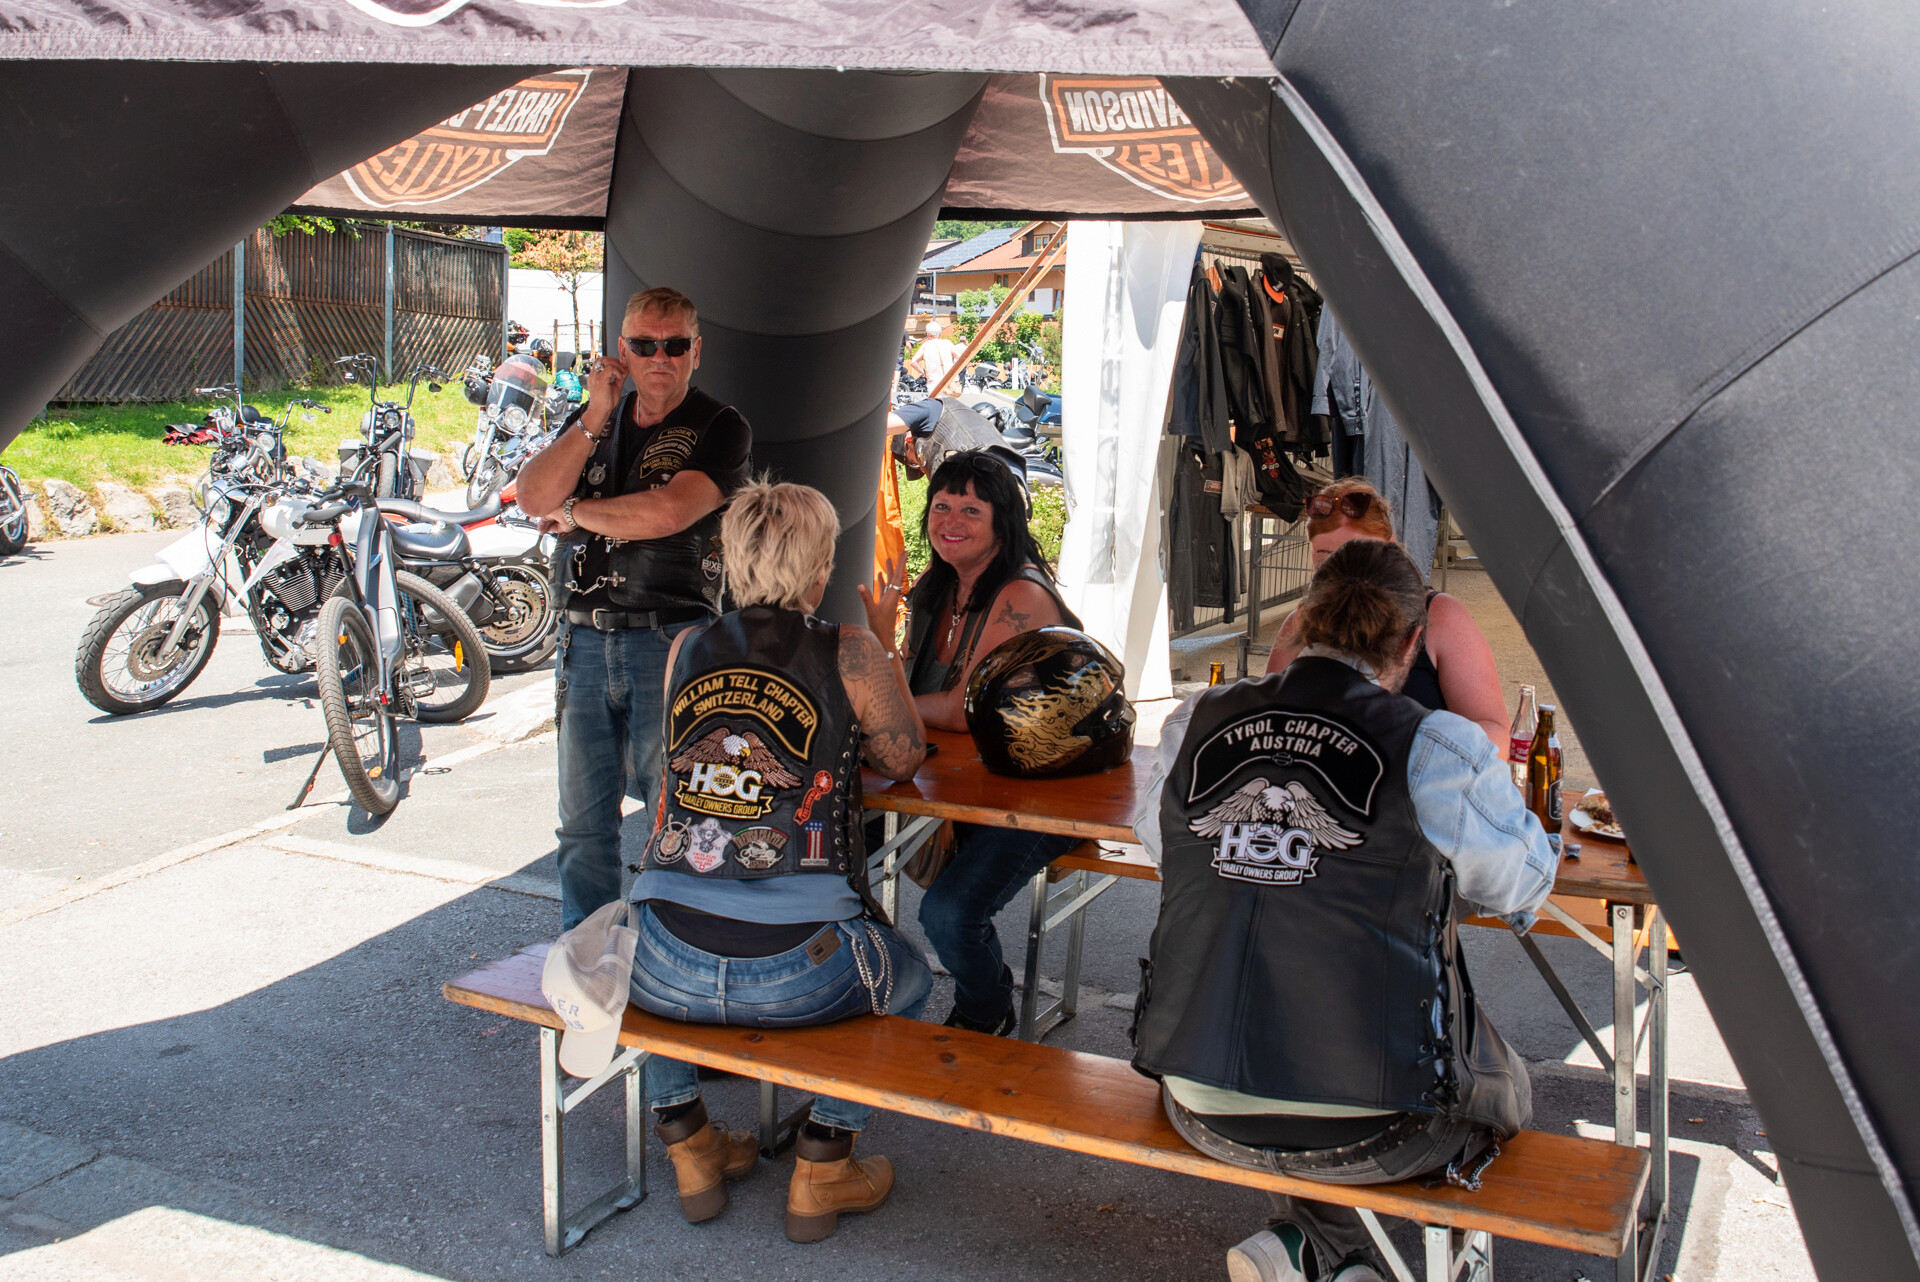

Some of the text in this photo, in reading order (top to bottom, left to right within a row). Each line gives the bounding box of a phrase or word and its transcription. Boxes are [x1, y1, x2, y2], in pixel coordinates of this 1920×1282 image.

[673, 675, 815, 729] WILLIAM TELL CHAPTER
[693, 691, 785, 723] SWITZERLAND
[1224, 718, 1358, 756] TYROL CHAPTER
[1250, 735, 1323, 758] AUSTRIA
[687, 762, 762, 803] HOG
[683, 793, 758, 815] HARLEY OWNERS GROUP
[1217, 822, 1313, 870] HOG
[1221, 861, 1299, 881] HARLEY OWNERS GROUP
